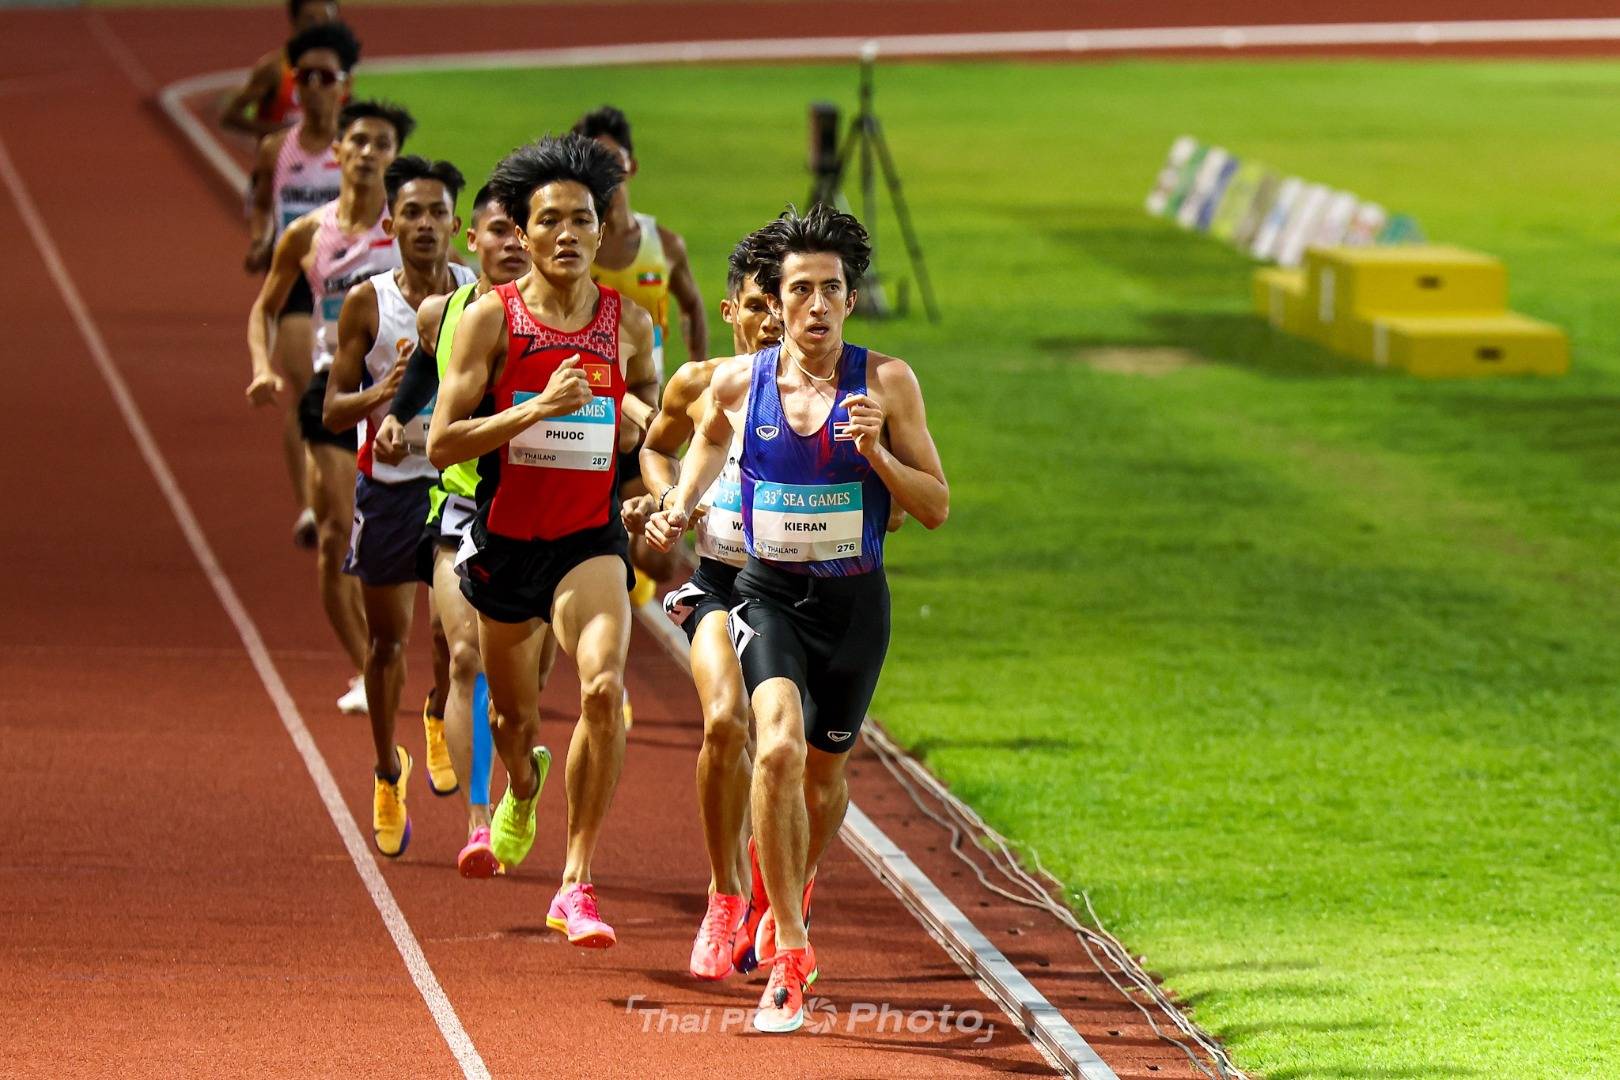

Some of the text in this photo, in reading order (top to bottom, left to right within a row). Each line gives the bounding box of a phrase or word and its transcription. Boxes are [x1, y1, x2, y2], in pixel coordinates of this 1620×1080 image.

[546, 430, 584, 440] PHUOC
[525, 453, 556, 461] THAILAND
[593, 457, 606, 465] 287
[783, 494, 805, 507] SEA
[809, 492, 850, 506] GAMES
[732, 520, 745, 532] W
[785, 522, 827, 531] KIERAN
[768, 545, 798, 554] THAILAND
[837, 544, 855, 552] 276
